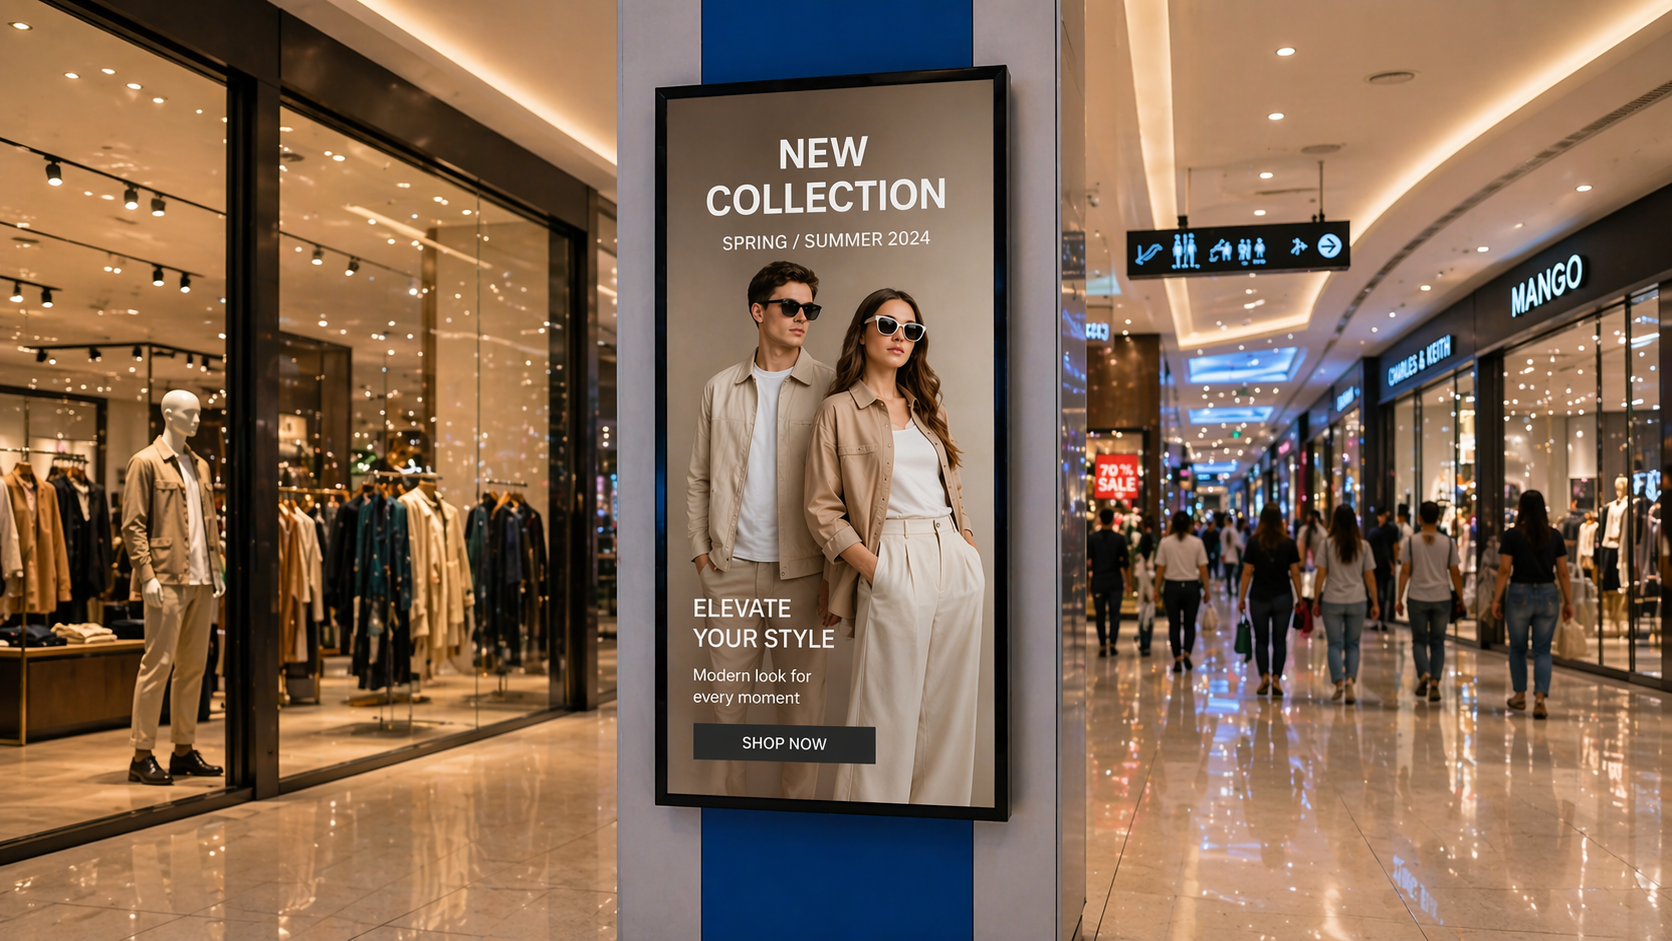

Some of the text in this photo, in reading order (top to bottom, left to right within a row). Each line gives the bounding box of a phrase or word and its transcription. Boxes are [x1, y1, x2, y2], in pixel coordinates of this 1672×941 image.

[779, 135, 869, 170] NEW
[706, 177, 946, 217] COLLECTION
[722, 229, 931, 251] SPRING / SUMMER 2024
[1511, 253, 1583, 318] MANGO
[1418, 349, 1426, 371] &
[1426, 333, 1452, 367] KEITH
[1098, 477, 1137, 492] SALE
[693, 598, 792, 618] ELEVATE
[693, 628, 836, 650] YOUR STYLE
[693, 668, 812, 684] Modern look for
[693, 692, 801, 707] every moment
[742, 736, 827, 752] SHOP NOW
